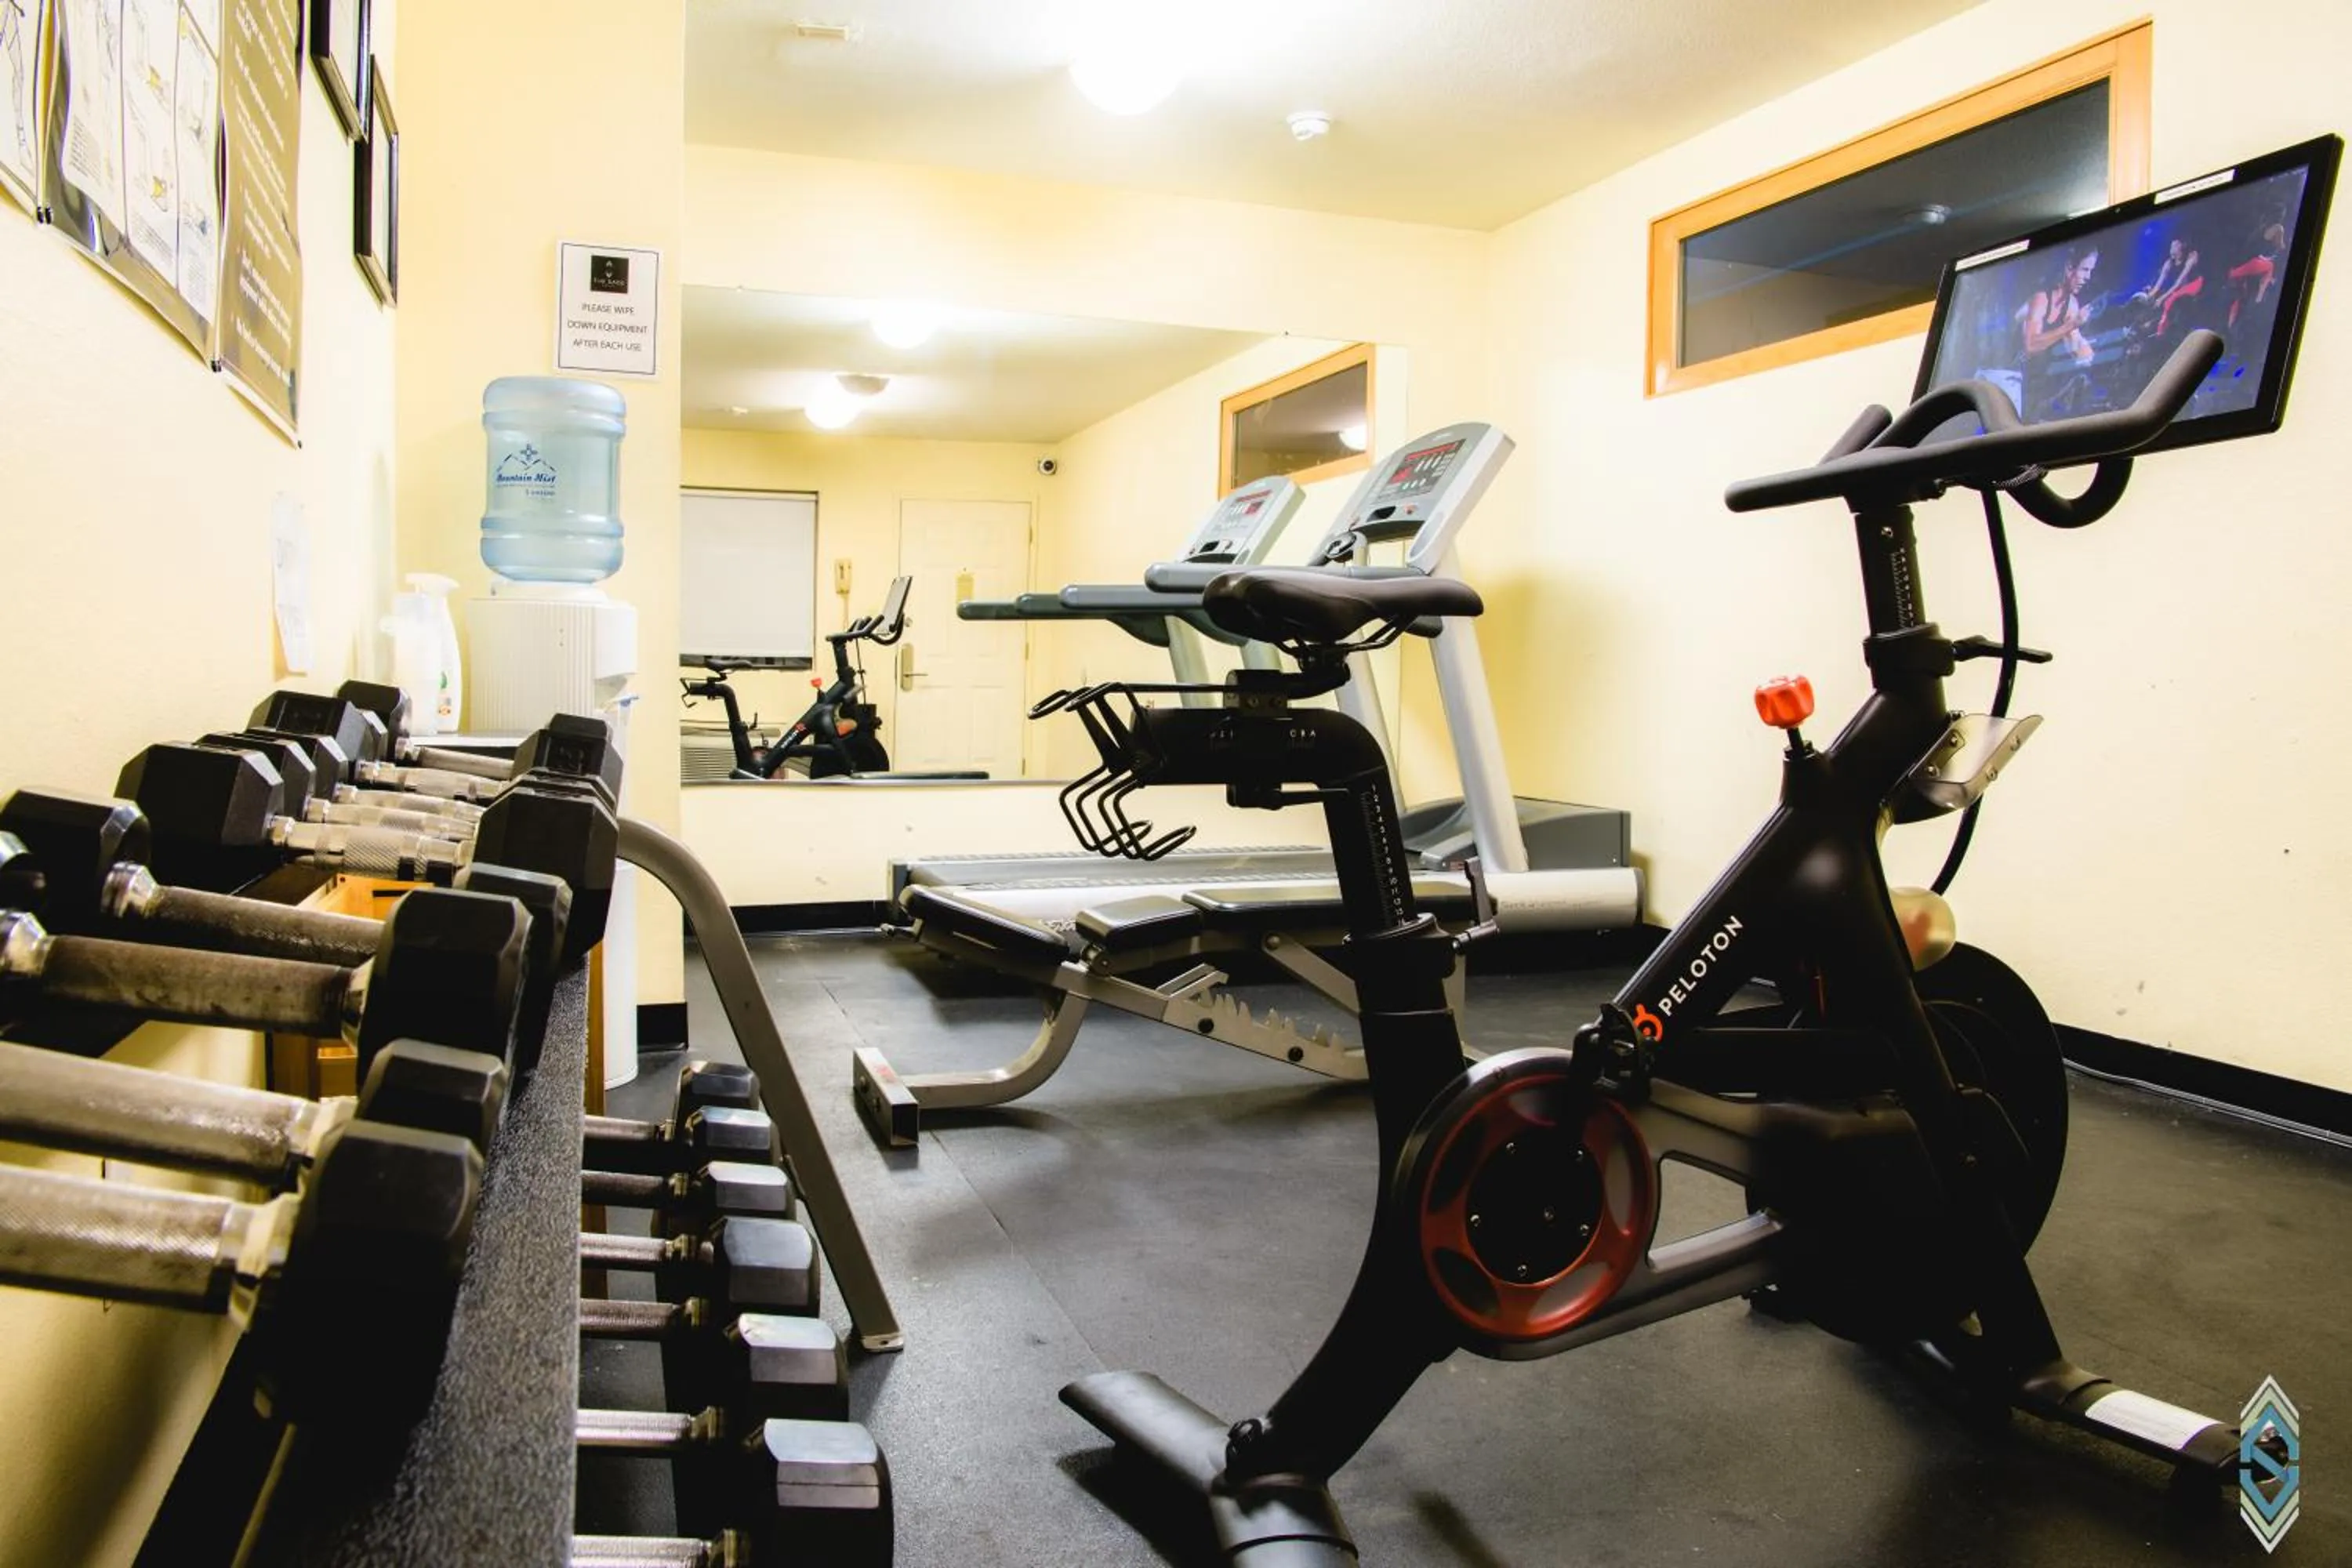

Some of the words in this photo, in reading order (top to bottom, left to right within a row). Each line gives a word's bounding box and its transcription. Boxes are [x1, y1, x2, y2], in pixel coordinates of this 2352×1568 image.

[581, 303, 612, 314] PLEASE
[614, 306, 635, 315] WIPE
[567, 320, 596, 329] DOWN
[598, 322, 648, 333] EQUIPMENT
[573, 338, 598, 348] AFTER
[601, 340, 623, 350] EACH
[626, 343, 641, 351] USE
[1658, 915, 1744, 1017] PELOTON
